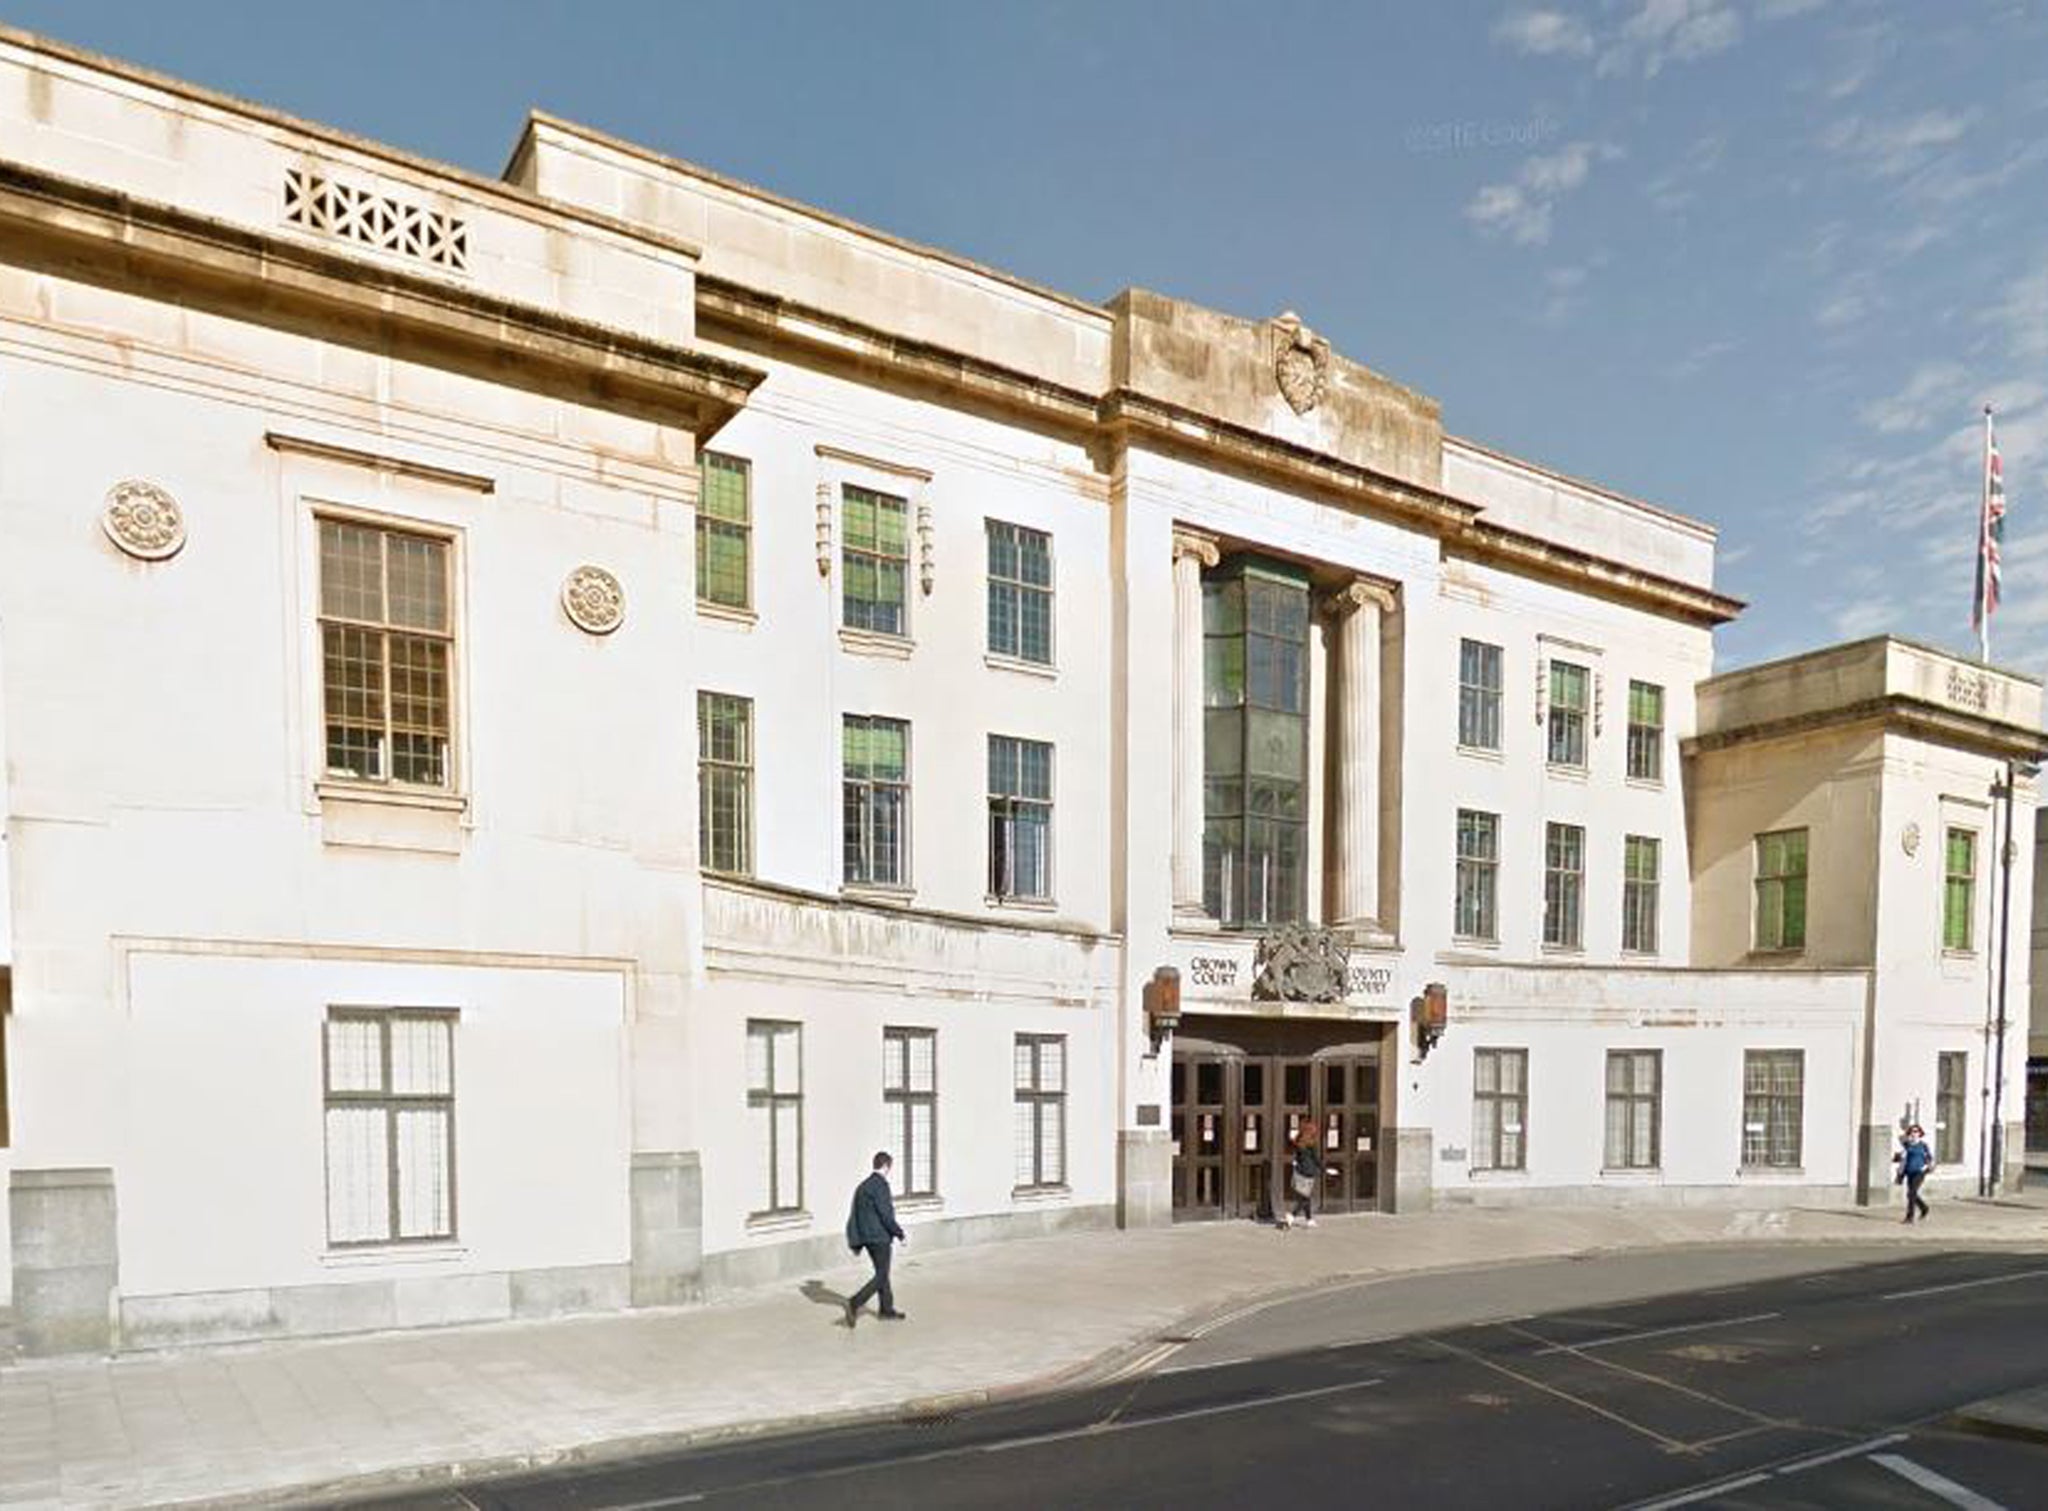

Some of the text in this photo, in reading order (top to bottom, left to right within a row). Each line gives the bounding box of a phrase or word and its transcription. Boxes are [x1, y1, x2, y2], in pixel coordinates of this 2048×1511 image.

[1191, 956, 1238, 972] CROWN
[1191, 971, 1237, 986] COURT
[1350, 966, 1392, 982] OUNTY
